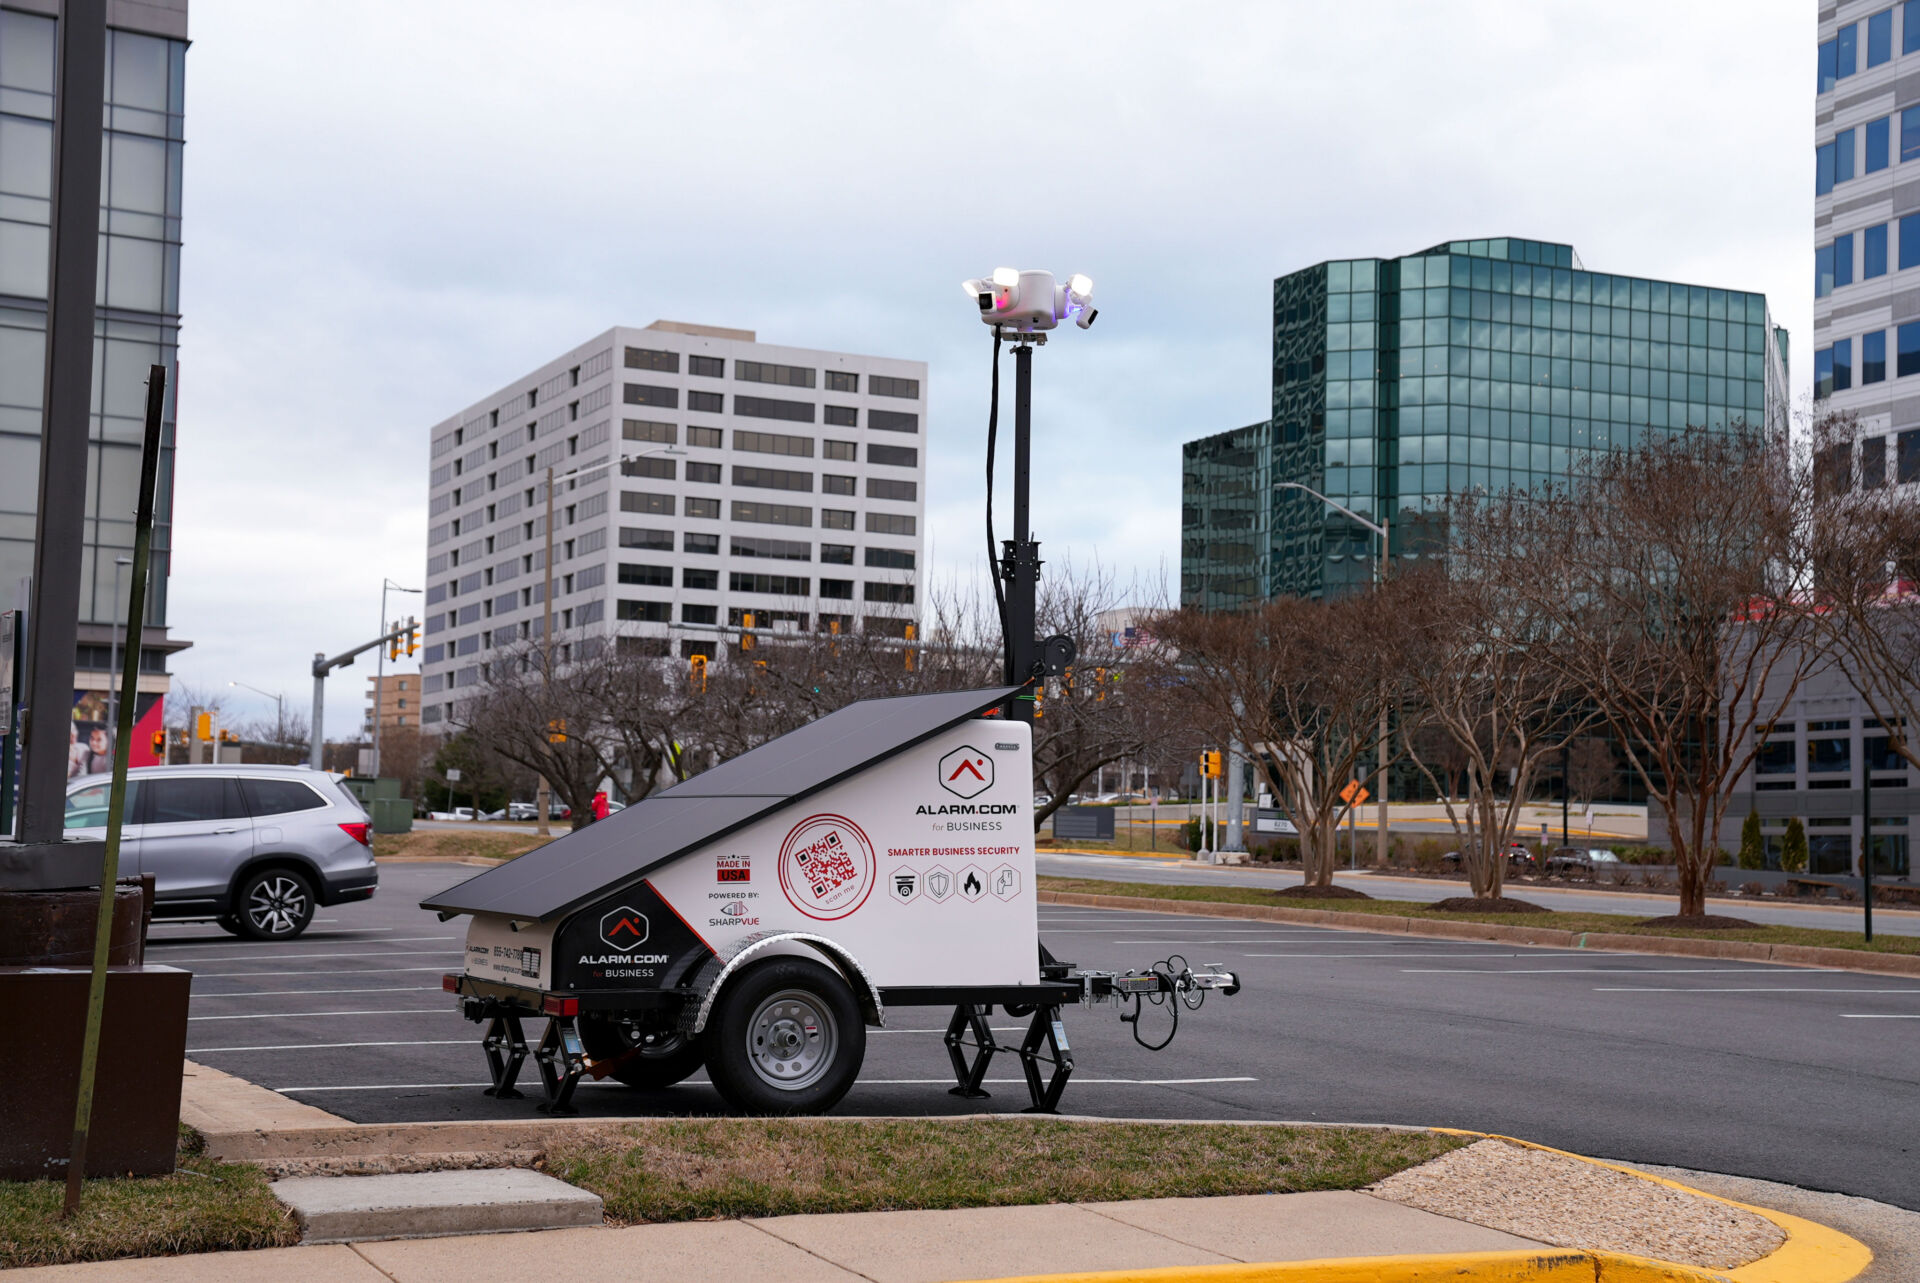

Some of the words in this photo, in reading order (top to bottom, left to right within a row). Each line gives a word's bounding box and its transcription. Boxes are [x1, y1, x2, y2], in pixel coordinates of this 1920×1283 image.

[915, 804, 1017, 815] ALARM.COM
[932, 822, 944, 831] for
[946, 821, 1003, 831] BUSINESS
[887, 848, 930, 857] SMARTER
[932, 847, 976, 856] BUSINESS
[977, 846, 1020, 855] SECURITY
[716, 860, 741, 868] MADE
[742, 860, 751, 868] IN
[721, 869, 746, 881] USA
[825, 890, 843, 905] scan
[843, 884, 855, 895] me
[708, 917, 760, 927] SHARPVUE
[578, 954, 667, 965] ALARM.COM
[605, 968, 655, 978] BUSINESS
